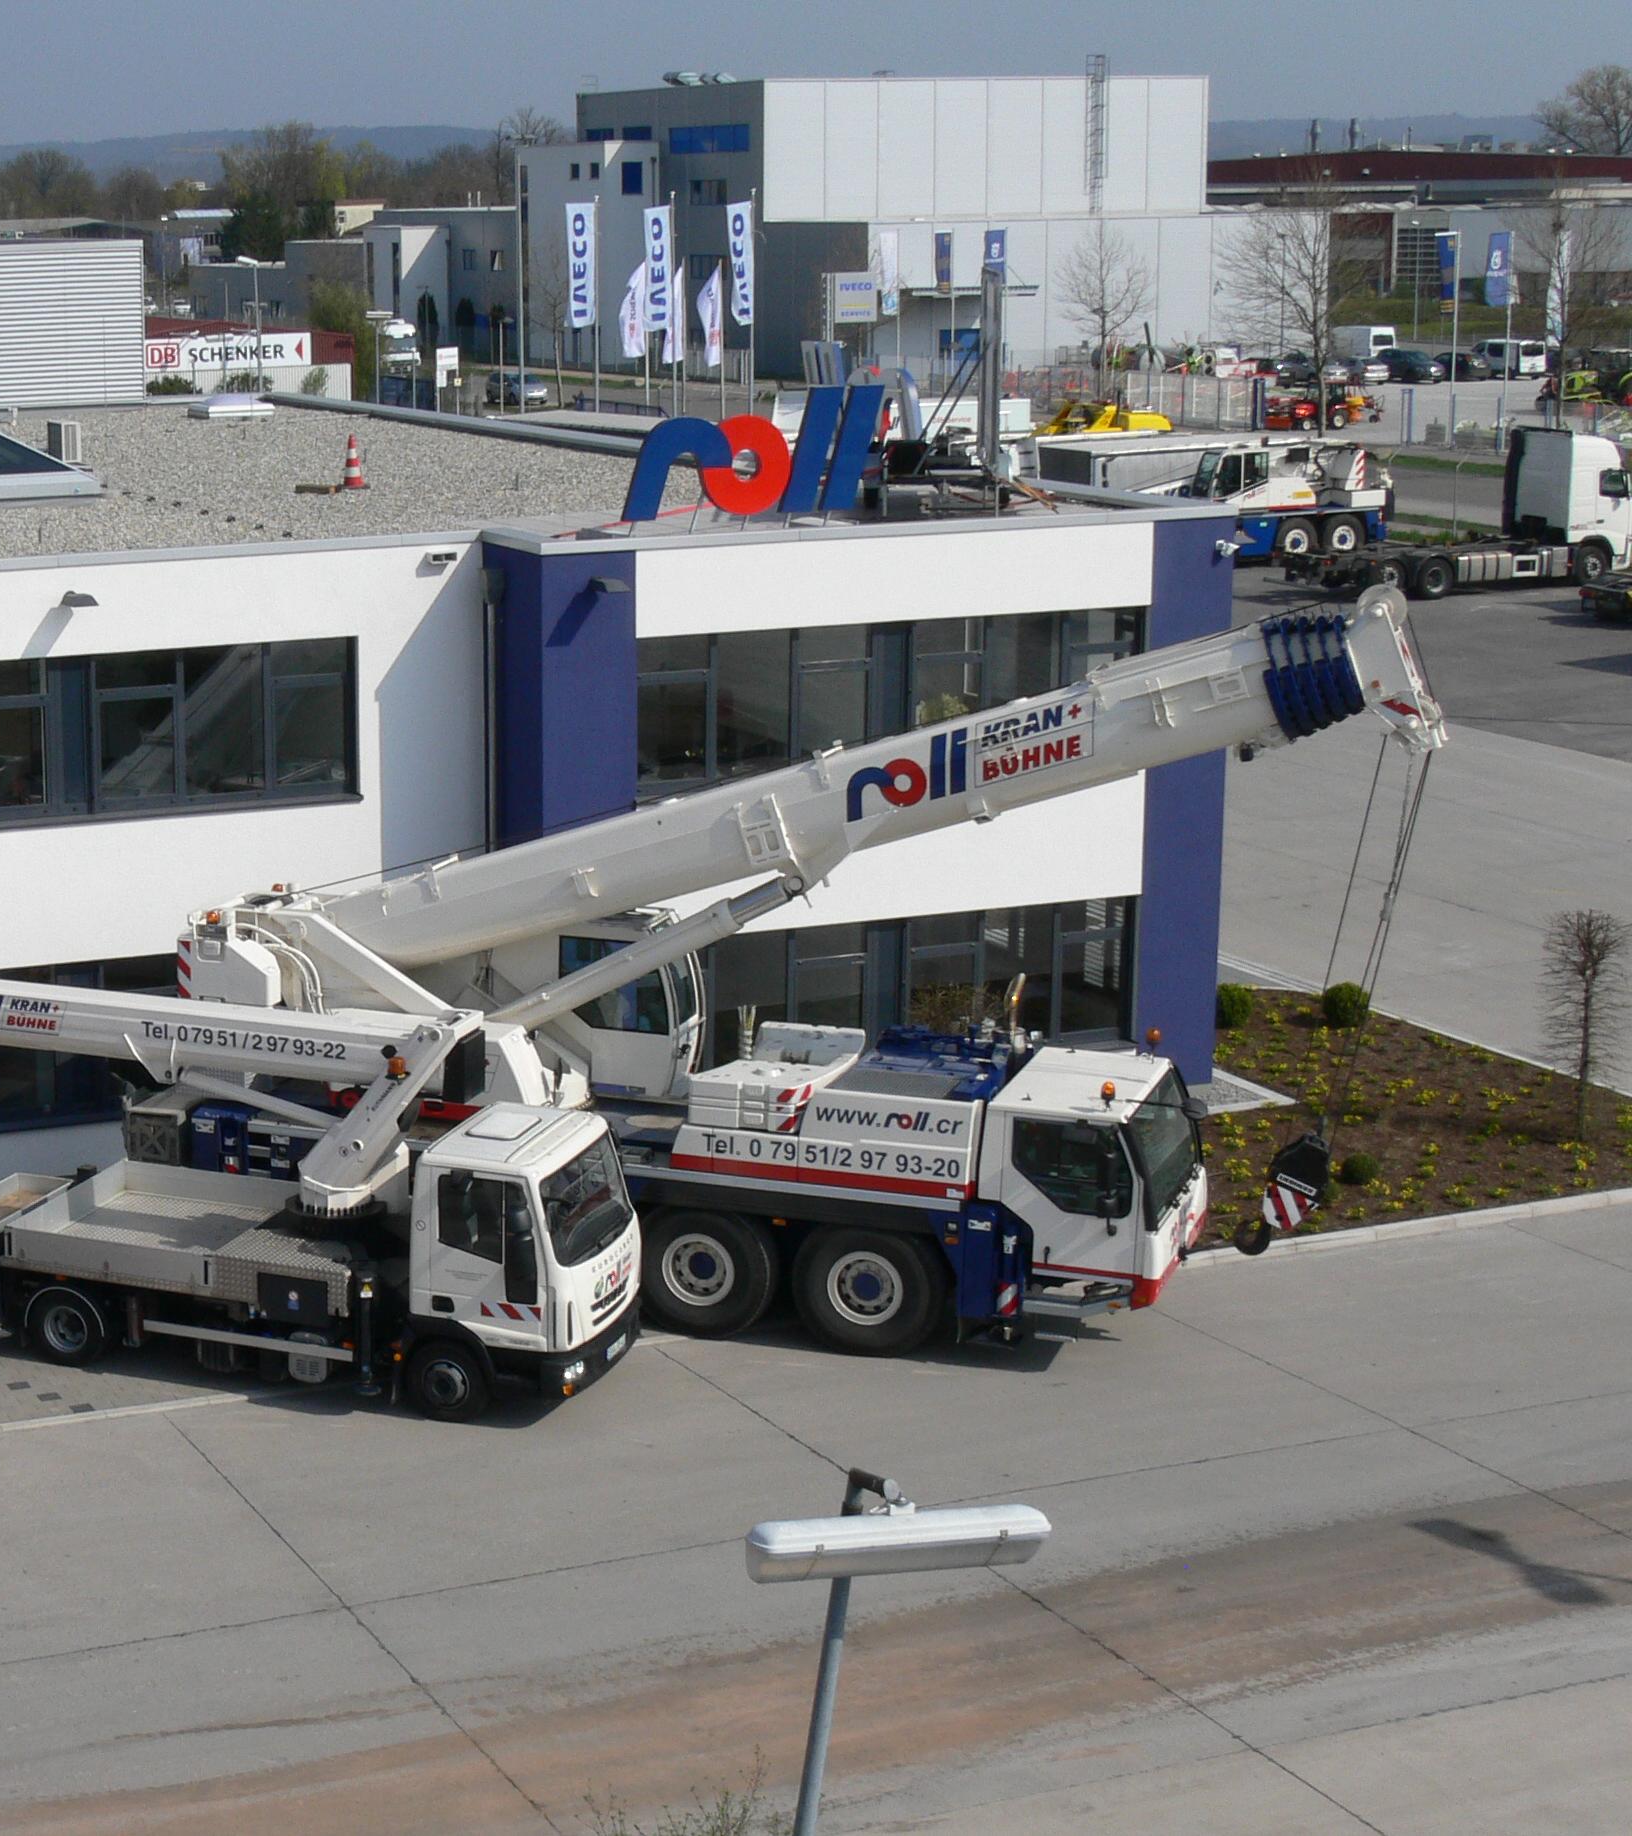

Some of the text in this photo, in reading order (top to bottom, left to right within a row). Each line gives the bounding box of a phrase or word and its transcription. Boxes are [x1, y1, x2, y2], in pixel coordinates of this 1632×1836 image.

[572, 213, 587, 318] IVECO
[650, 217, 666, 322] IVECO
[840, 282, 872, 291] IVECO
[148, 344, 285, 366] DB SCHENKER
[621, 384, 885, 521] roll
[847, 727, 967, 822] roll
[983, 735, 1081, 781] BÜHNE
[7, 1013, 57, 1031] BÜHNE
[293, 1039, 346, 1060] 93-22
[702, 1133, 960, 1178] Tel. 0 79 51/2 97 93-20
